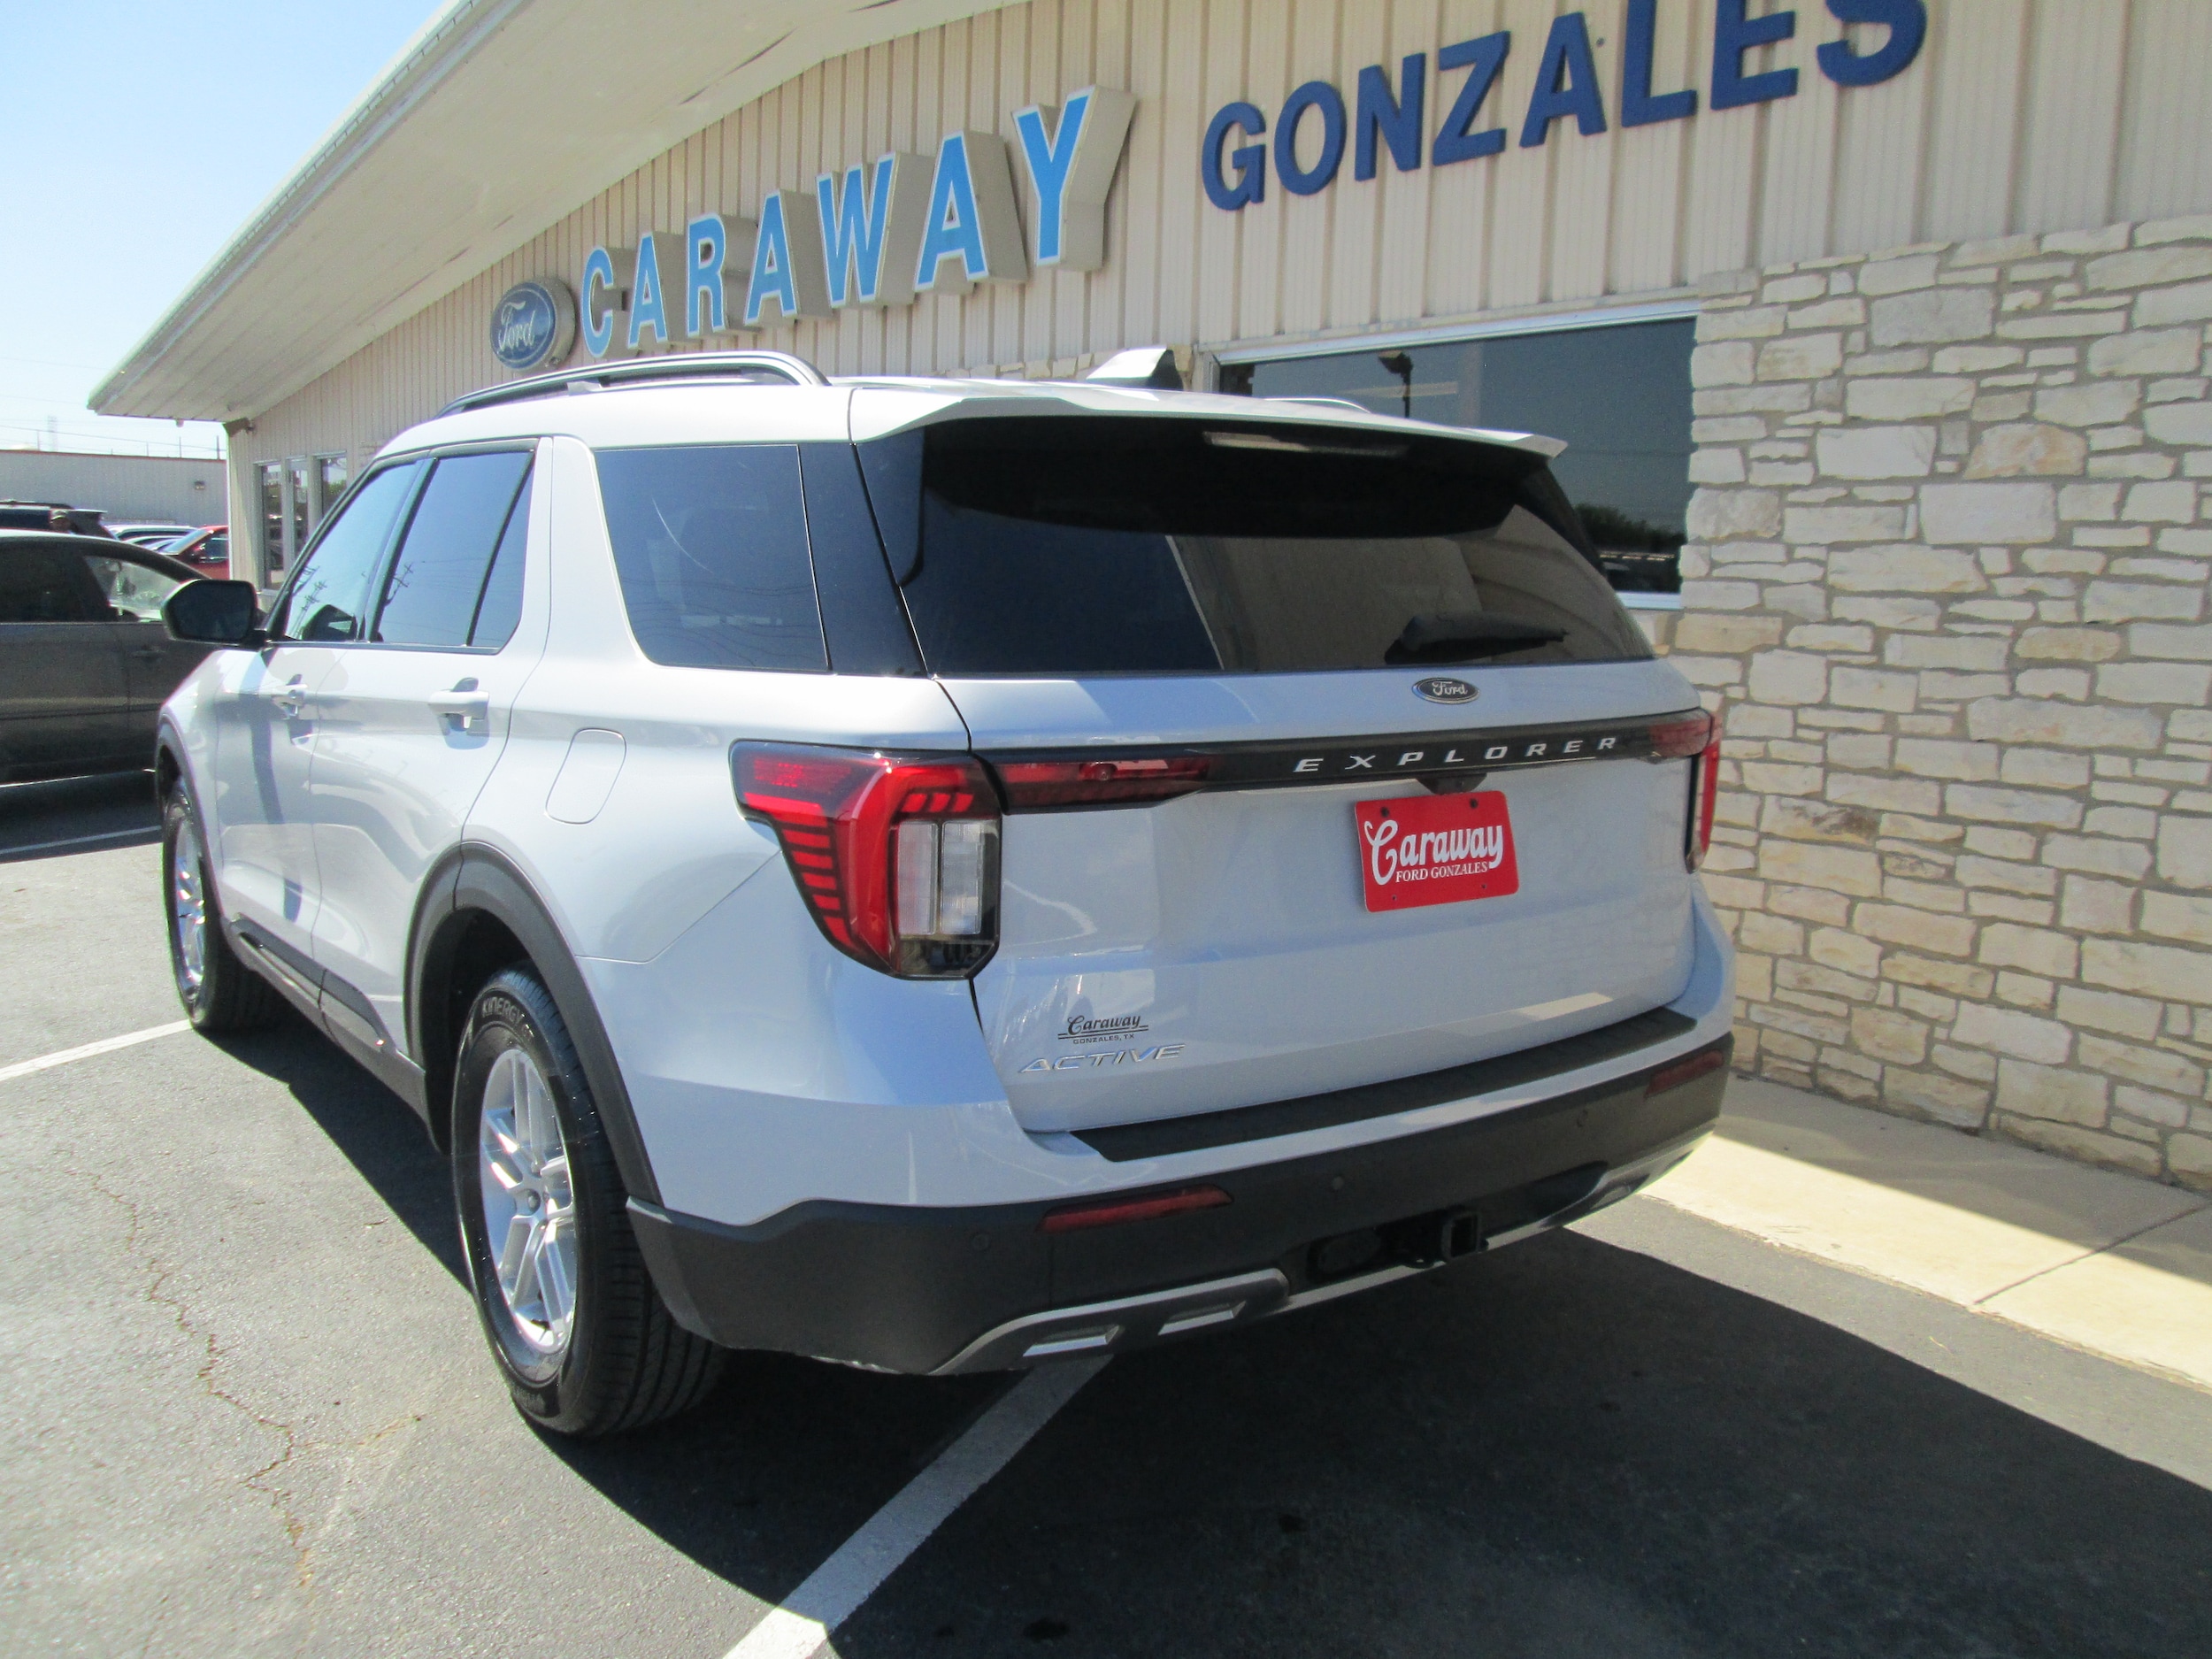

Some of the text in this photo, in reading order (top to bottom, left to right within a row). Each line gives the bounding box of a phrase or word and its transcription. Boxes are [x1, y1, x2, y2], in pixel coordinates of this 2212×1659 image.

[1201, 0, 1929, 212] GONZALES
[580, 84, 1097, 357] CARAWAY
[497, 301, 536, 354] Ford
[1432, 681, 1468, 696] Ford
[1294, 736, 1617, 773] EXPLORER
[1363, 819, 1503, 885] Caraway
[1395, 861, 1488, 883] FORD GONZALES
[1067, 1015, 1141, 1035] Caraway
[1073, 1035, 1122, 1044] GONZALES,
[1018, 1044, 1186, 1074] ACTIVE
